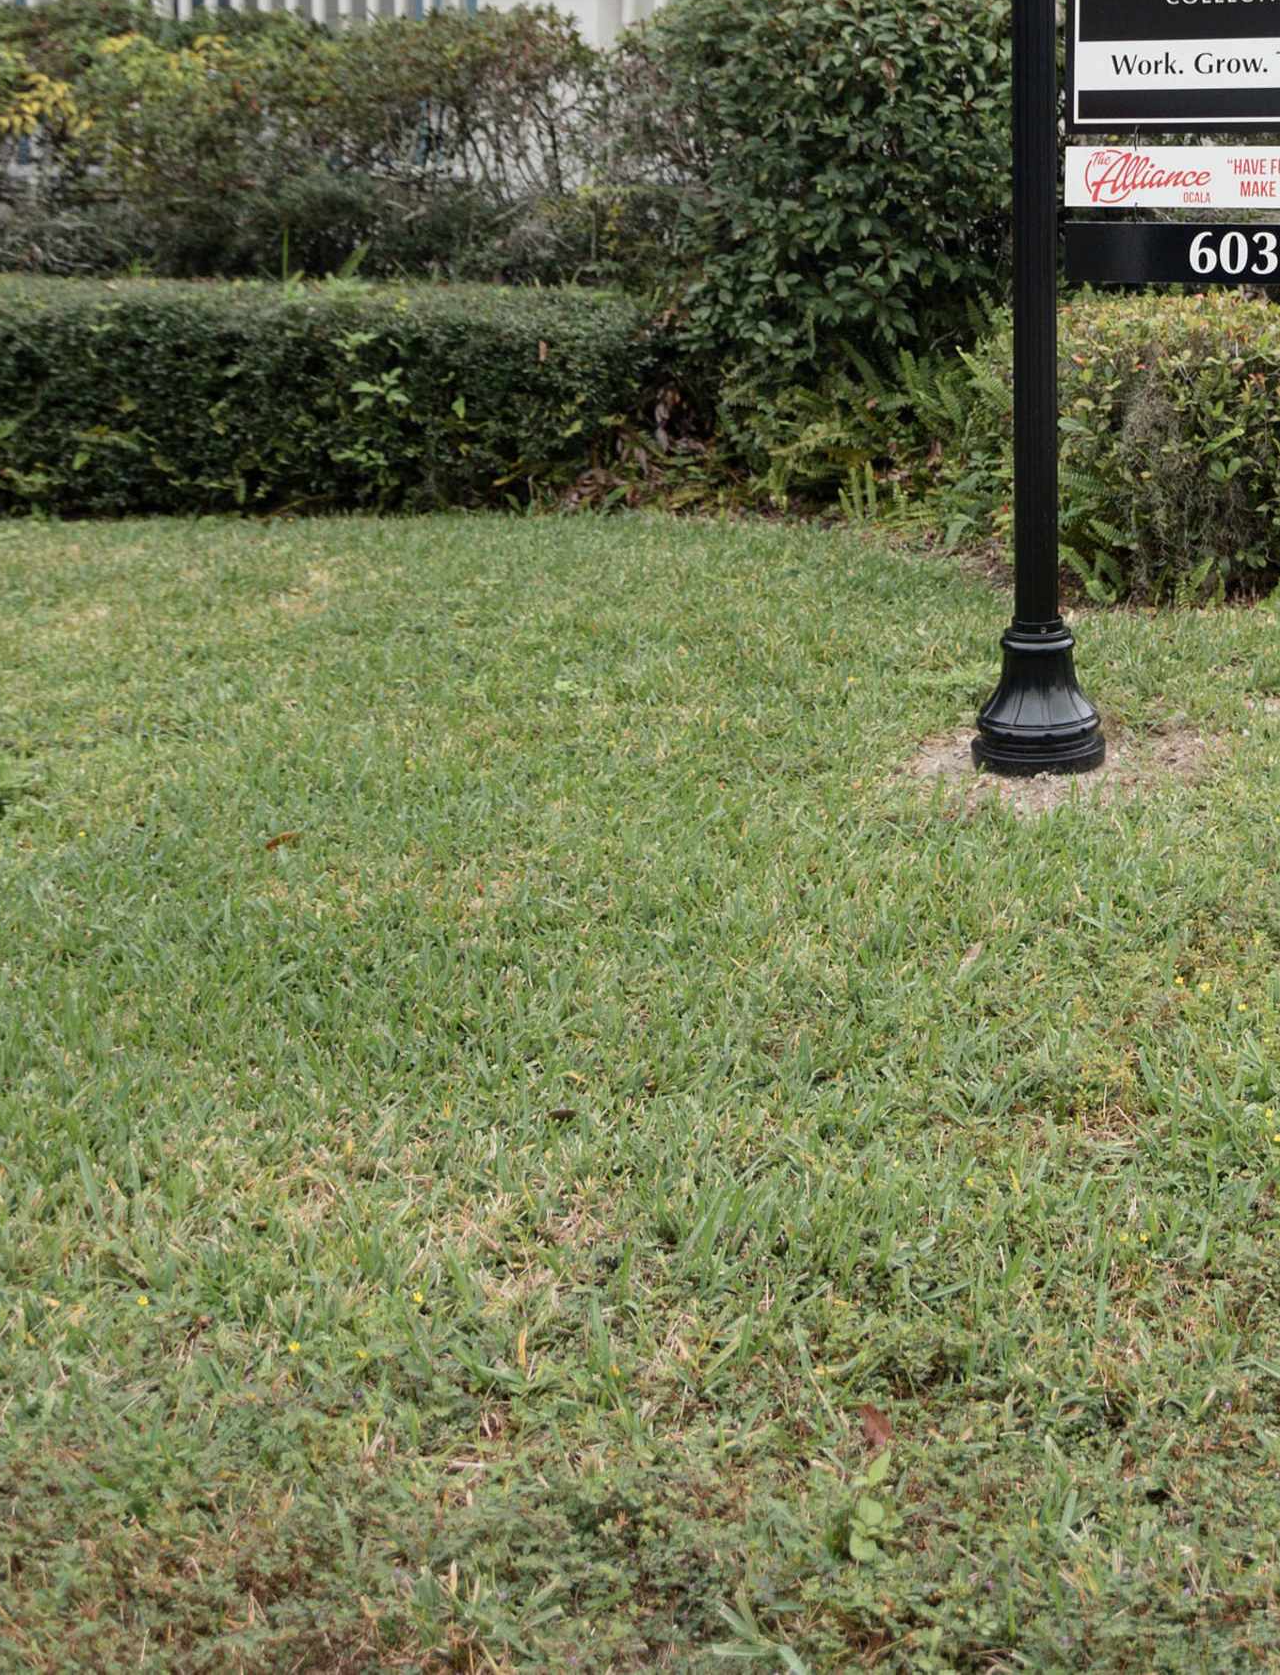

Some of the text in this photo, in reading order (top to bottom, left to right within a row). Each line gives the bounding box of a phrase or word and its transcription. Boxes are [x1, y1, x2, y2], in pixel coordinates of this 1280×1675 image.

[1111, 53, 1184, 76] Work.
[1194, 52, 1268, 75] Grow.
[1090, 151, 1111, 167] The
[1226, 158, 1267, 176] “HAVE
[1091, 152, 1212, 203] Alliance
[1183, 191, 1211, 203] OCALA
[1239, 181, 1277, 198] MAKE
[1188, 231, 1279, 275] 603
